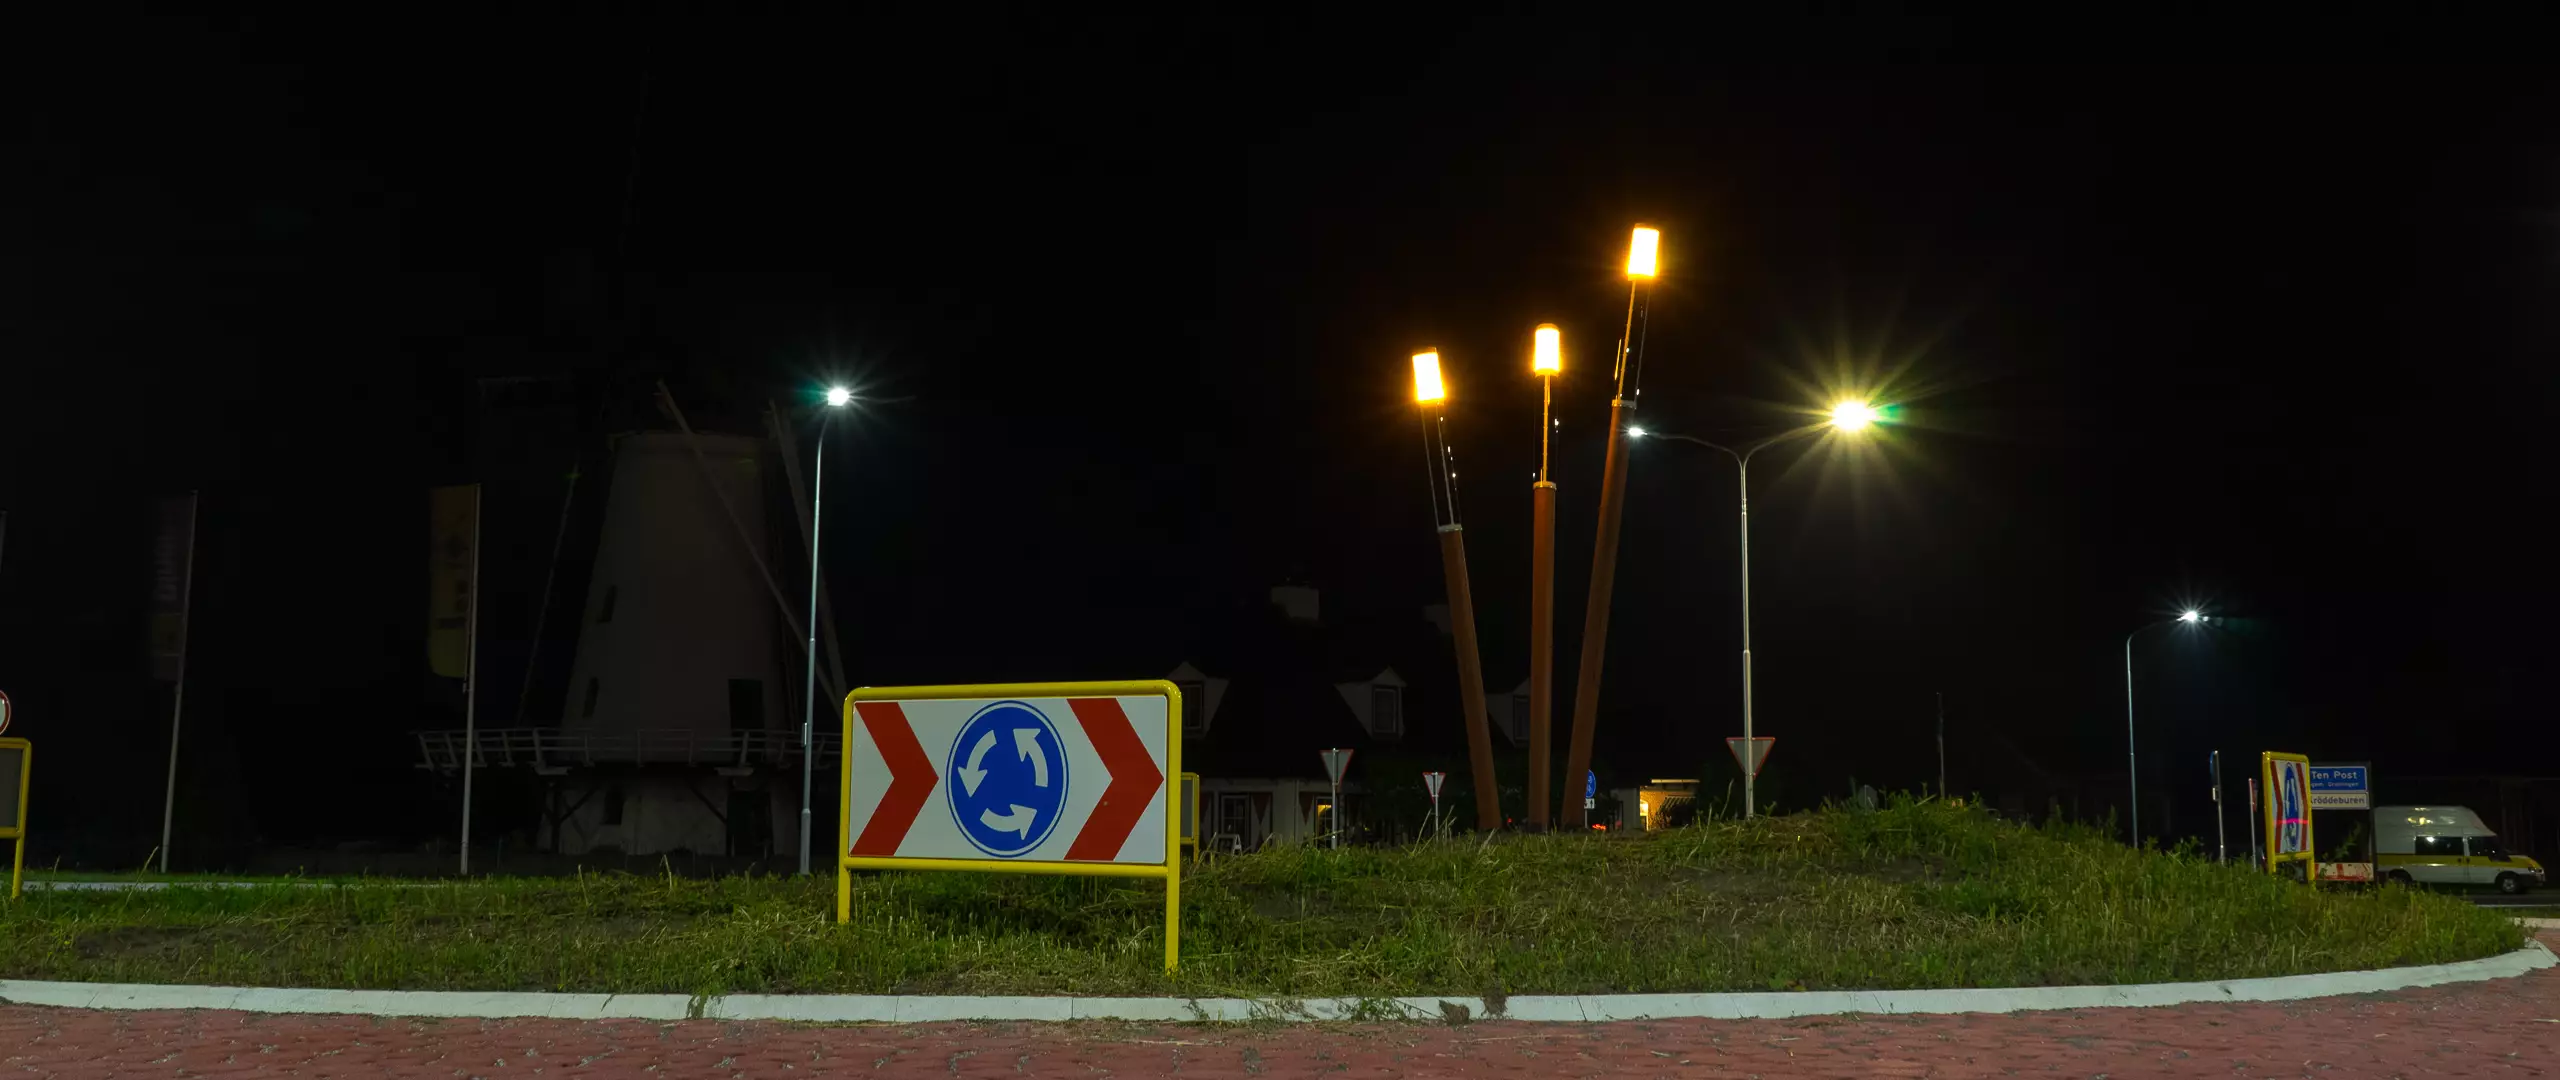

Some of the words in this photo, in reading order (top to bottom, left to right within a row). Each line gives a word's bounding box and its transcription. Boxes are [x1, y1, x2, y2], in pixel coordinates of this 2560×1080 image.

[2311, 771, 2330, 779] Ten
[2333, 770, 2358, 779] Post
[2311, 796, 2365, 804] röddeburen
